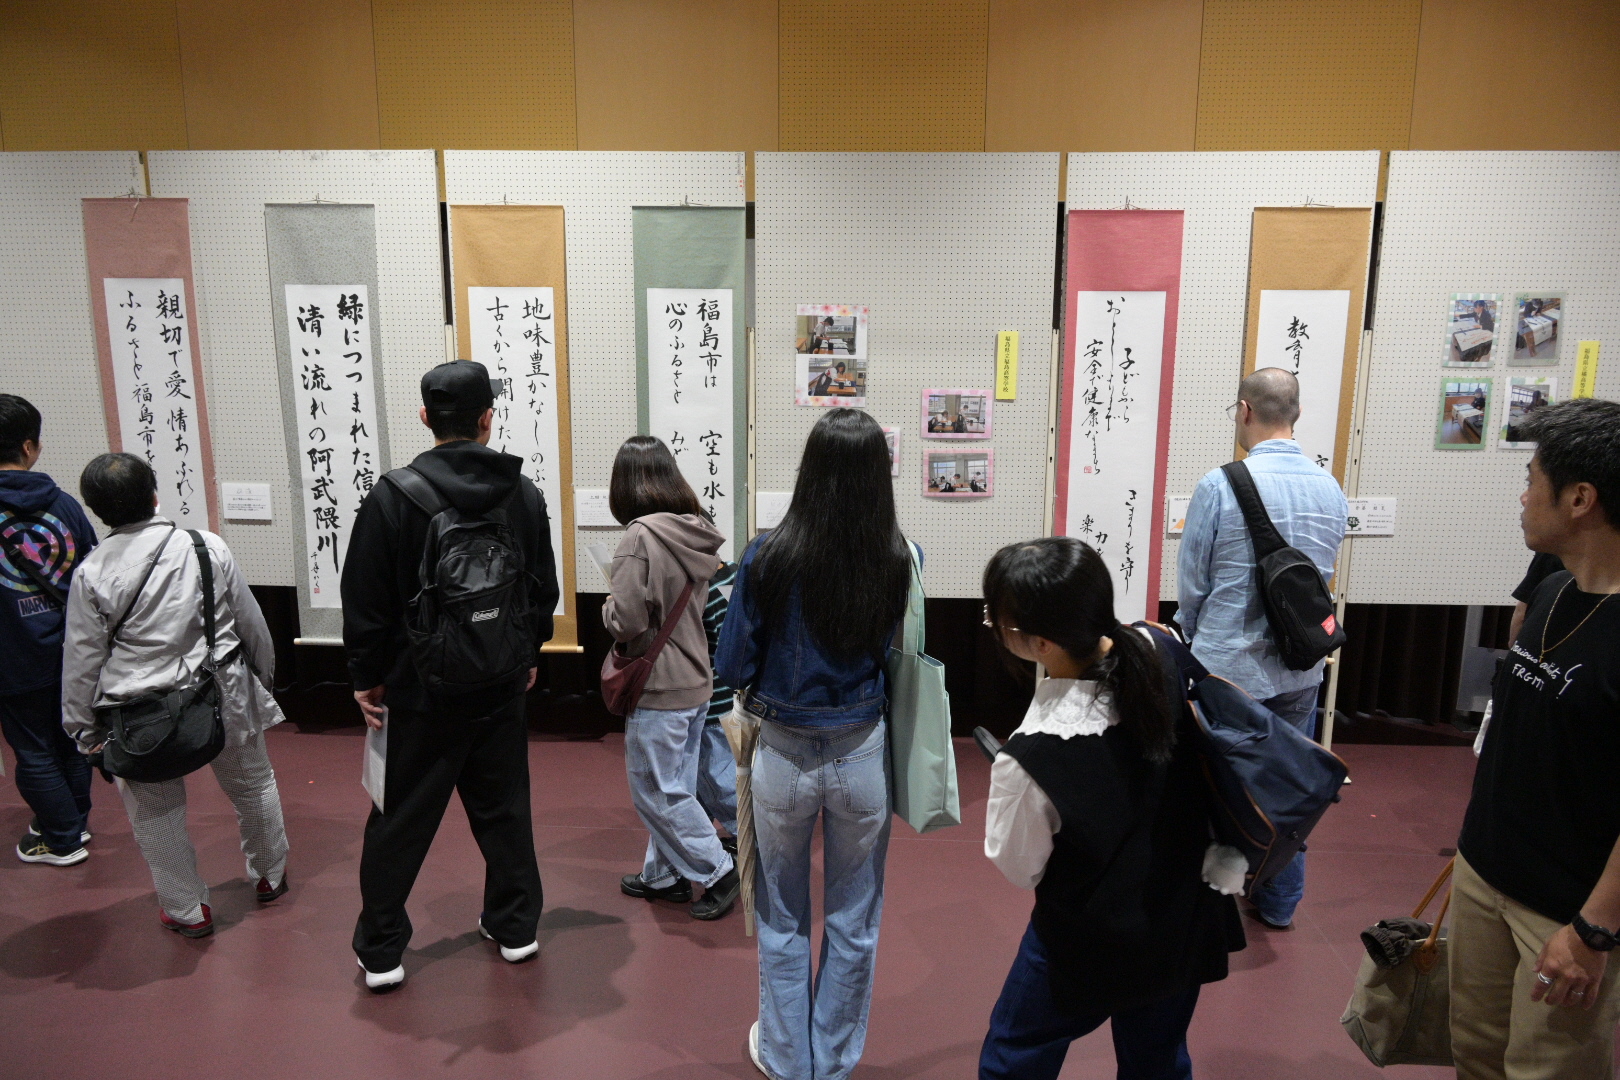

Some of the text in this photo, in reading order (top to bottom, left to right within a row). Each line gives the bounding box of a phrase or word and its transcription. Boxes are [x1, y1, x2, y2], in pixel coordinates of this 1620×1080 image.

[119, 290, 157, 477] ふるさと福島市を
[155, 289, 195, 515] 親切で愛情あふれる
[296, 303, 342, 574] 清い流れの阿武隈川
[665, 302, 688, 404] 心のふるさと
[696, 298, 726, 527] 福島市は 空も水も
[1285, 315, 1310, 376] 教育
[18, 594, 59, 618] MARV
